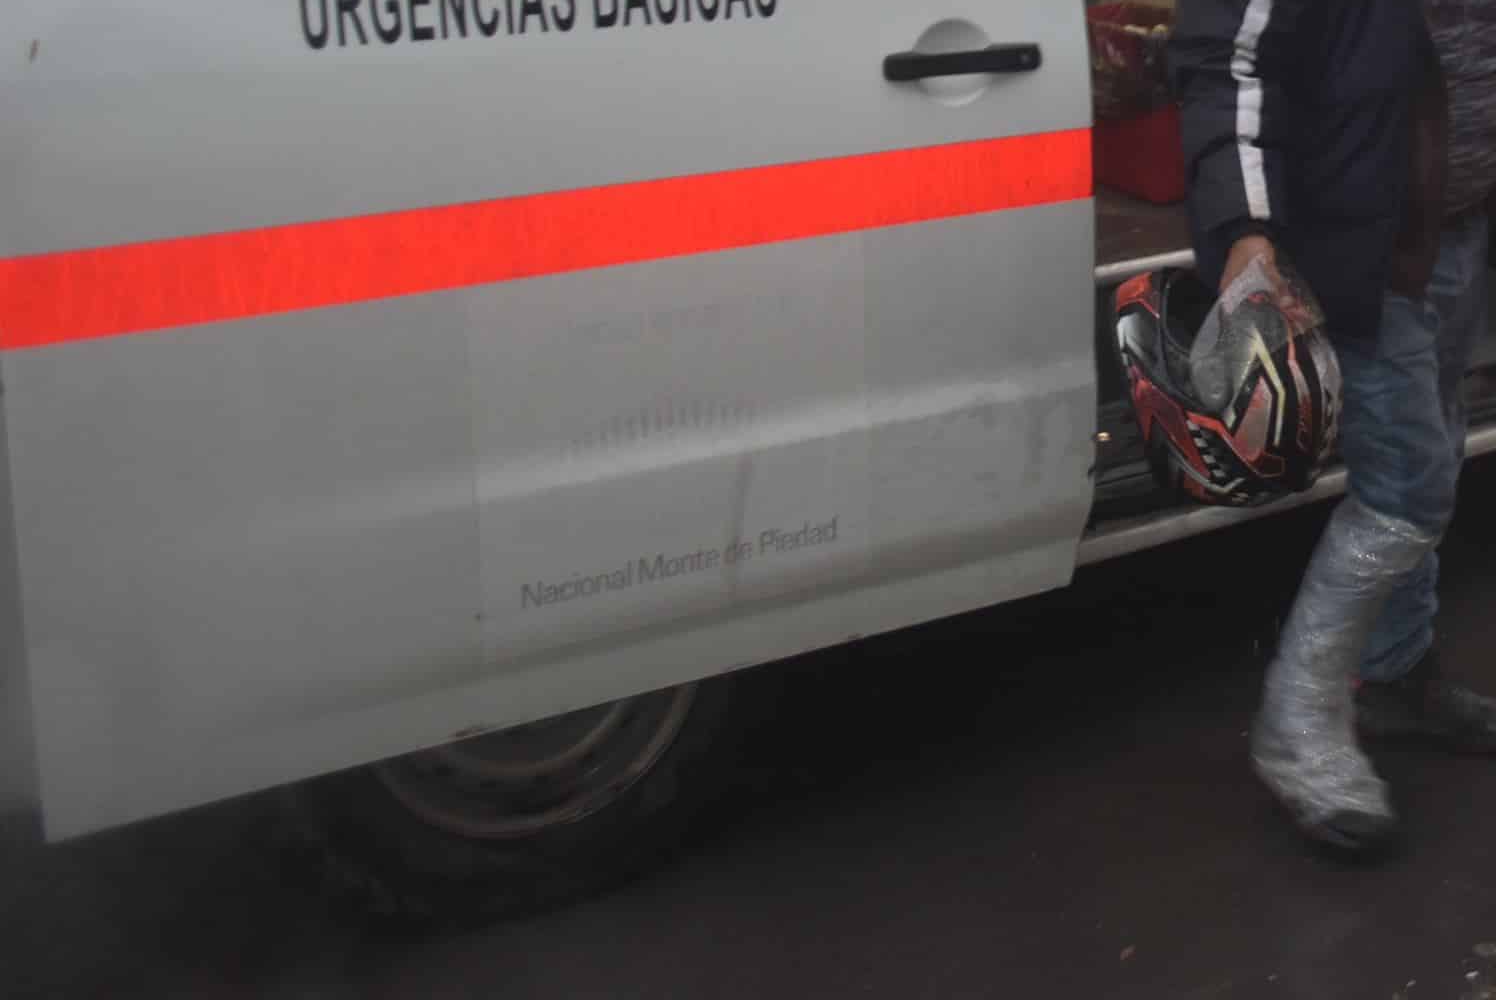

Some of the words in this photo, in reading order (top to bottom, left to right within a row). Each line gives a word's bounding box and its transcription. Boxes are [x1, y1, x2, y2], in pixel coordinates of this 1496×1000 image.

[521, 564, 632, 608] Nacional
[637, 543, 721, 585] Monte
[724, 535, 753, 565] de
[758, 515, 839, 555] Piedad
